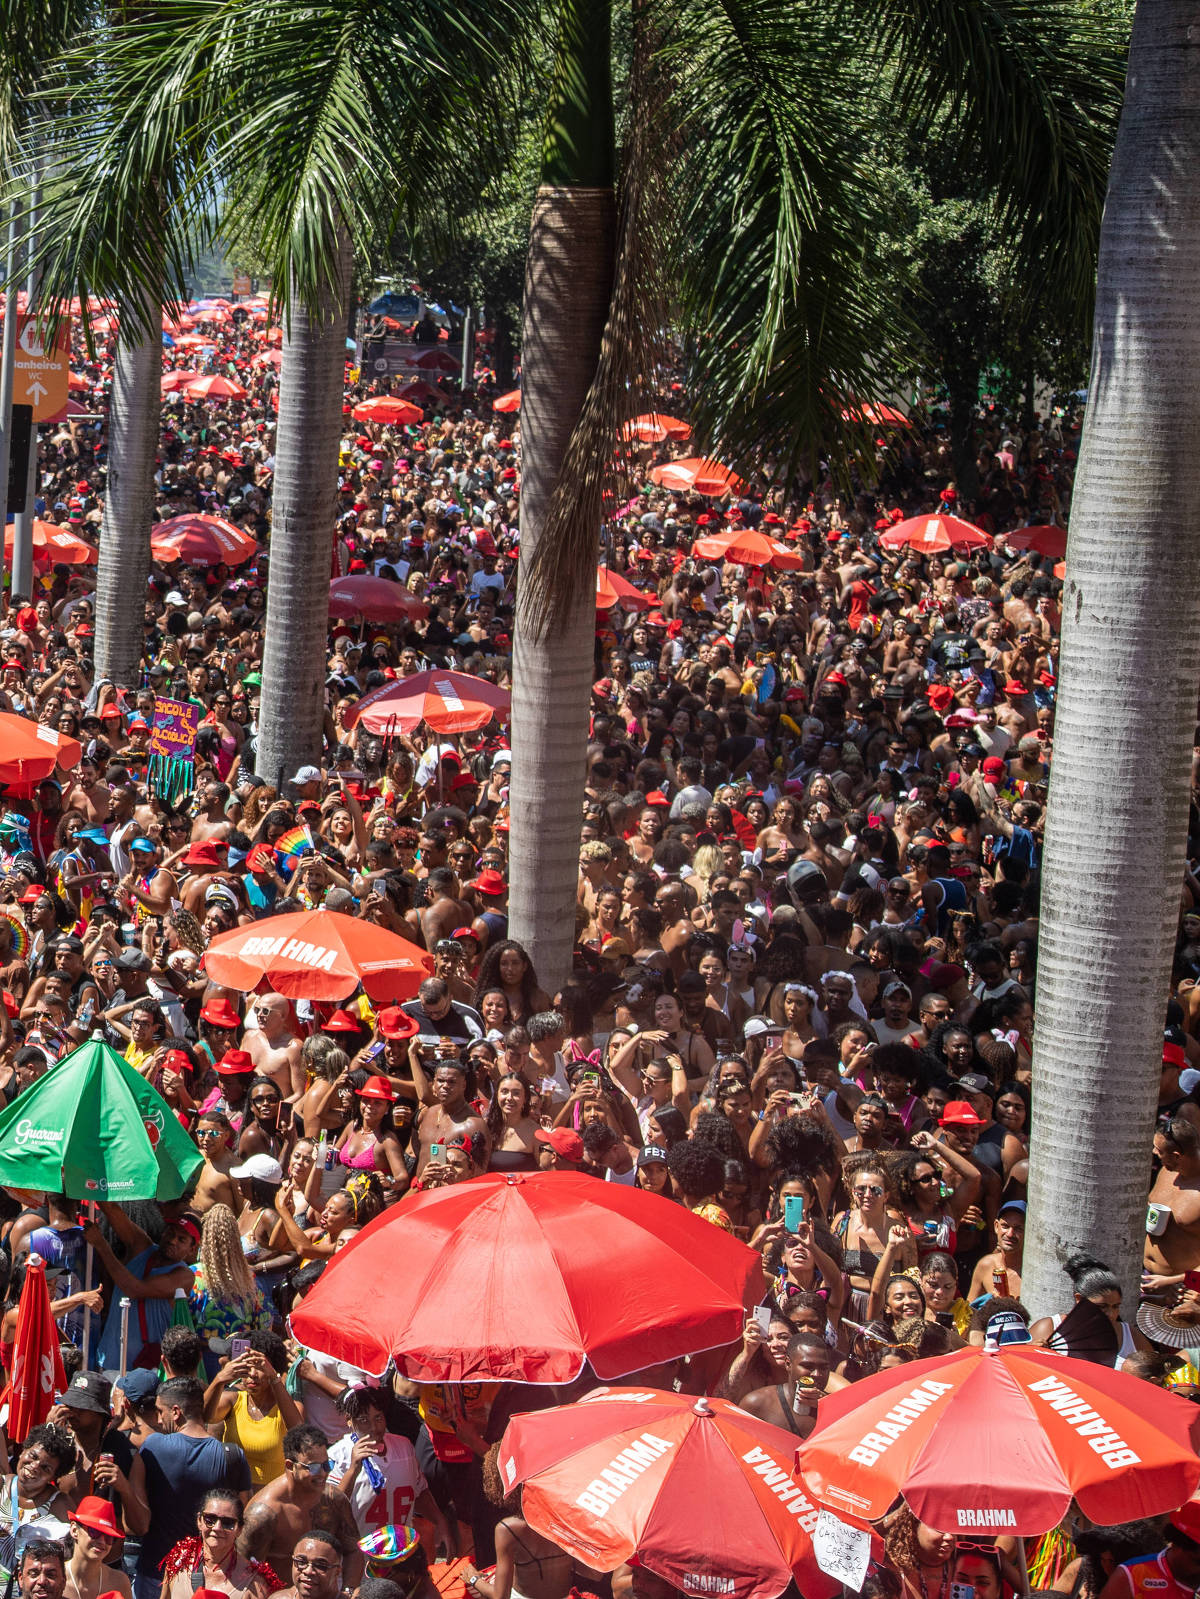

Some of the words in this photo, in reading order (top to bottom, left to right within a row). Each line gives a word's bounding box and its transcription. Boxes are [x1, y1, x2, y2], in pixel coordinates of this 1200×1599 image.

[239, 936, 338, 971] BRAHMA
[848, 1379, 955, 1467] BRAHMA
[1027, 1375, 1142, 1469] BRAHMA
[575, 1432, 674, 1518] BRAHMA
[741, 1446, 819, 1541] RAHMA
[957, 1509, 1017, 1527] BRAHMA
[683, 1573, 736, 1595] BRAHMA
